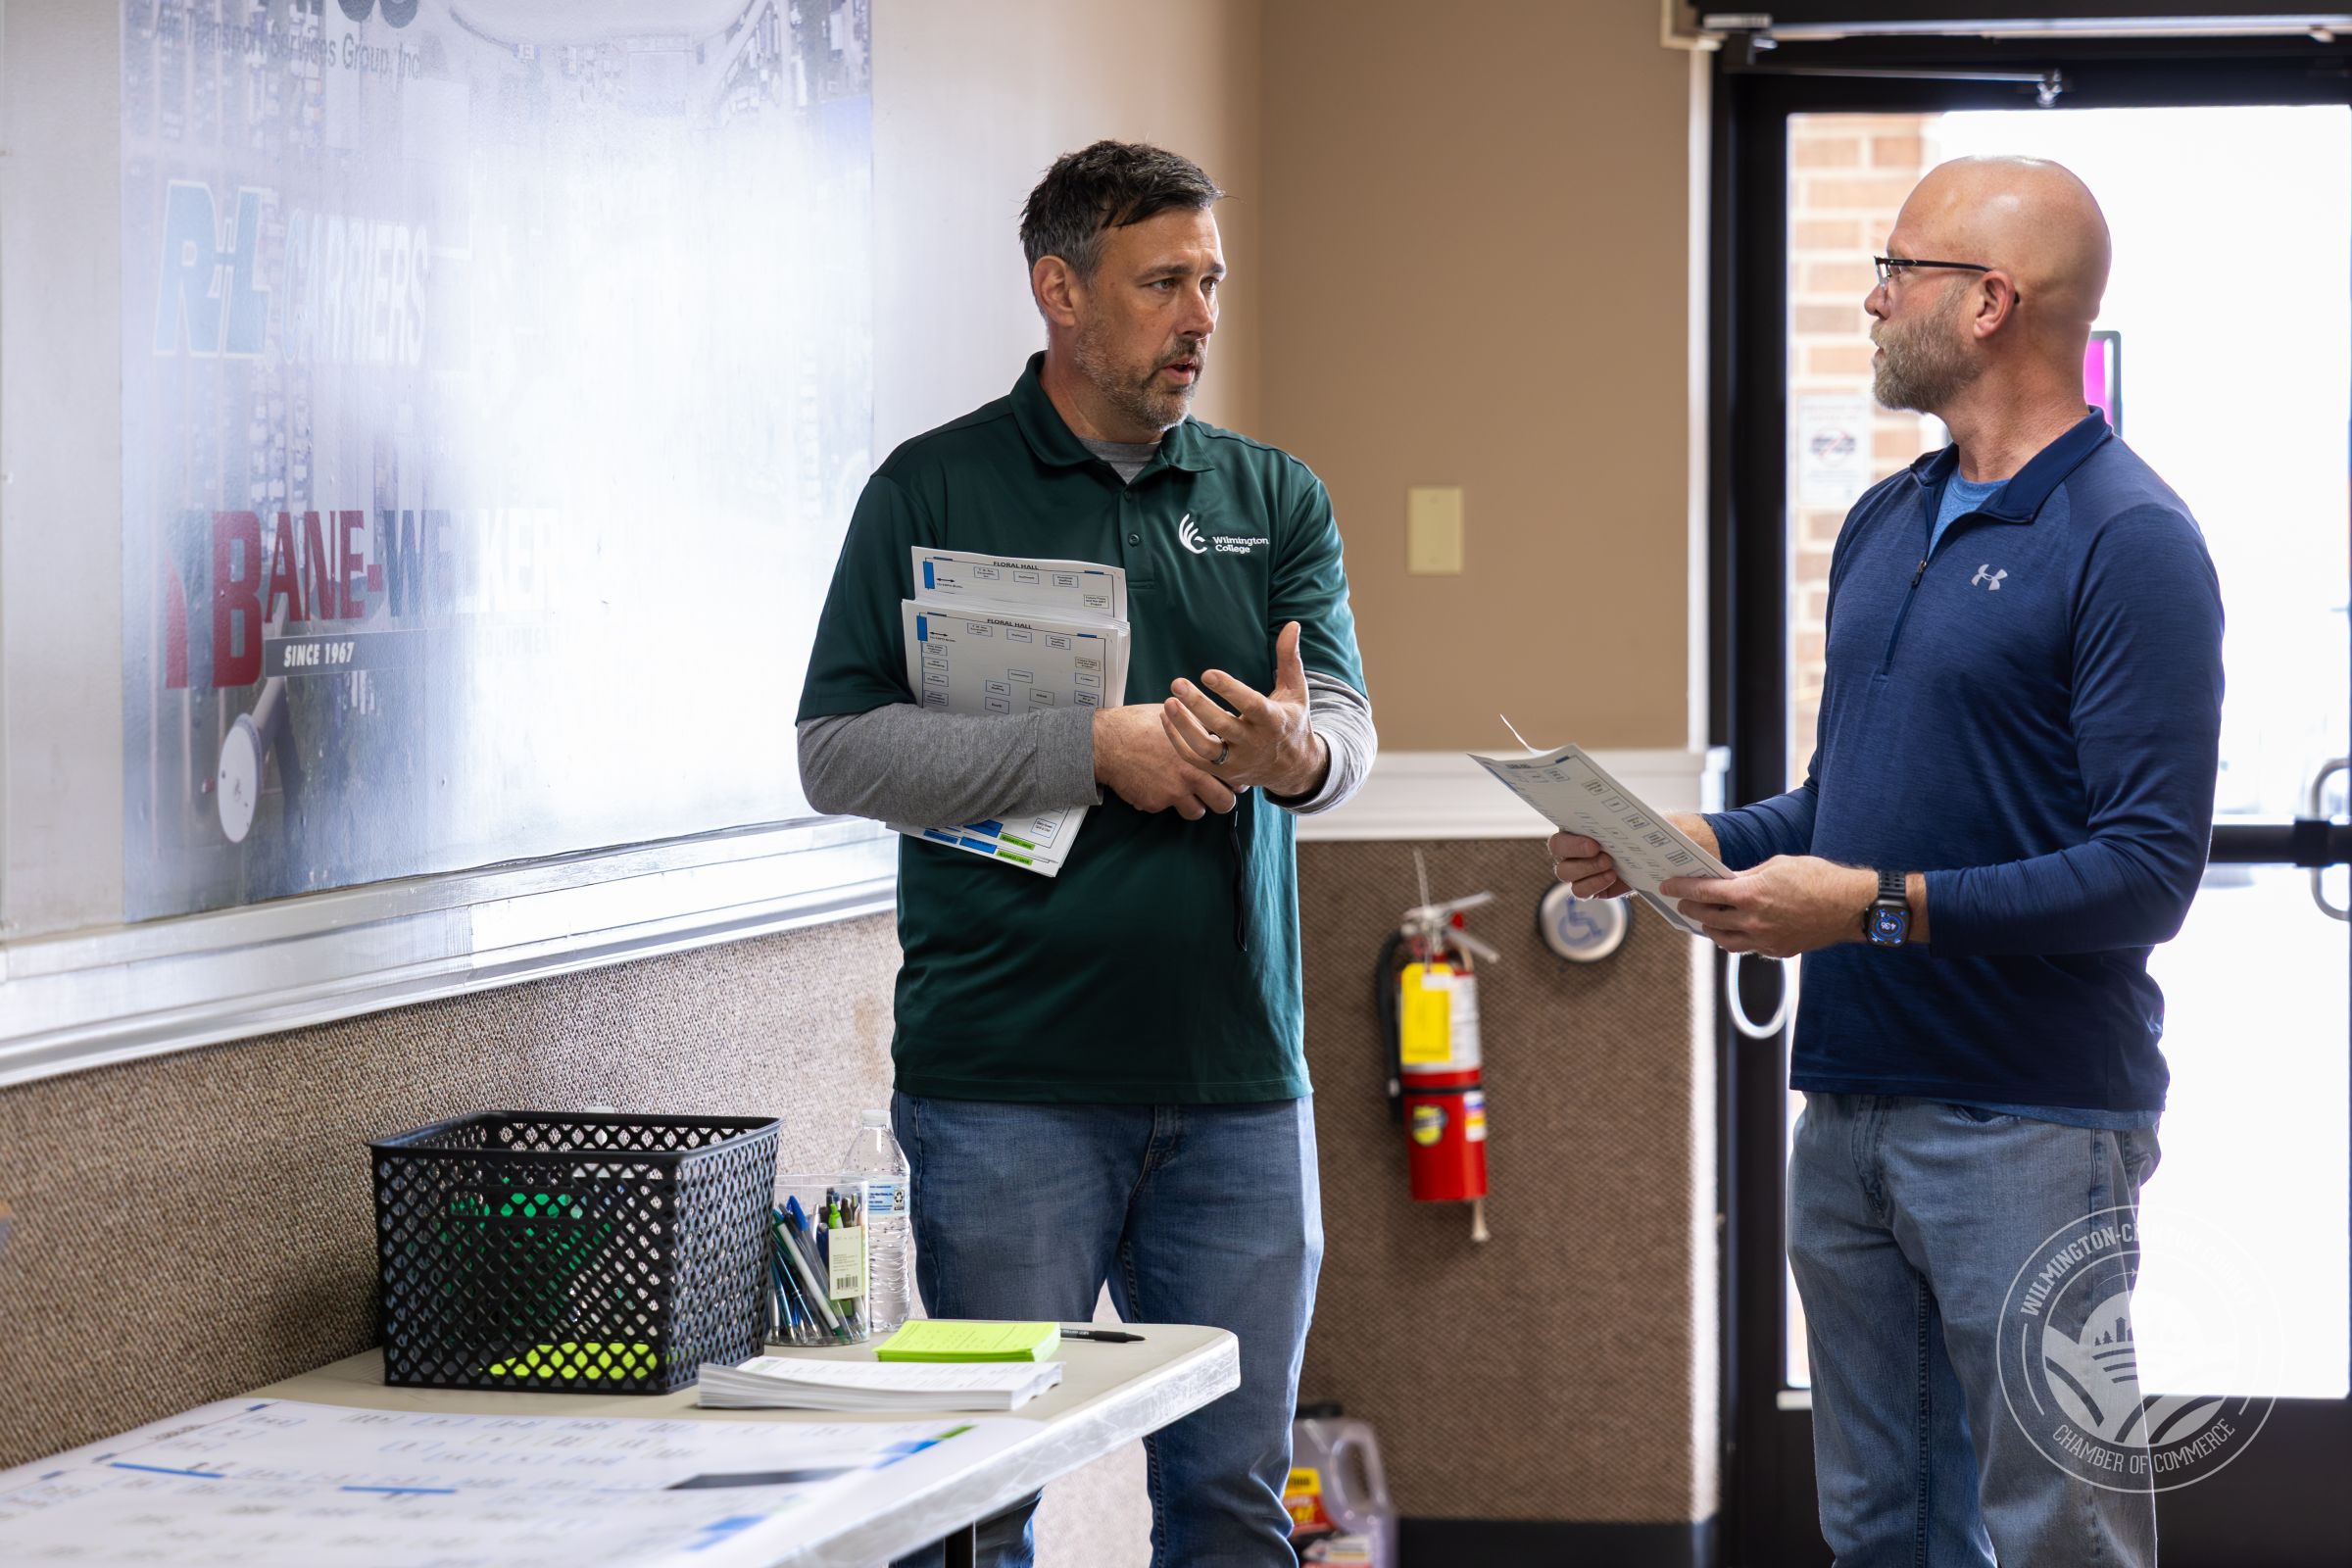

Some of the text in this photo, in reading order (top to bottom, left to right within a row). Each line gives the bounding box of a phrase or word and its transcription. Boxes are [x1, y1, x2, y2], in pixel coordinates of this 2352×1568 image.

[281, 207, 428, 365] CARRIERS
[1212, 536, 1269, 547] Wilmington
[1215, 545, 1250, 554] College
[283, 642, 355, 667] SINCE 1967
